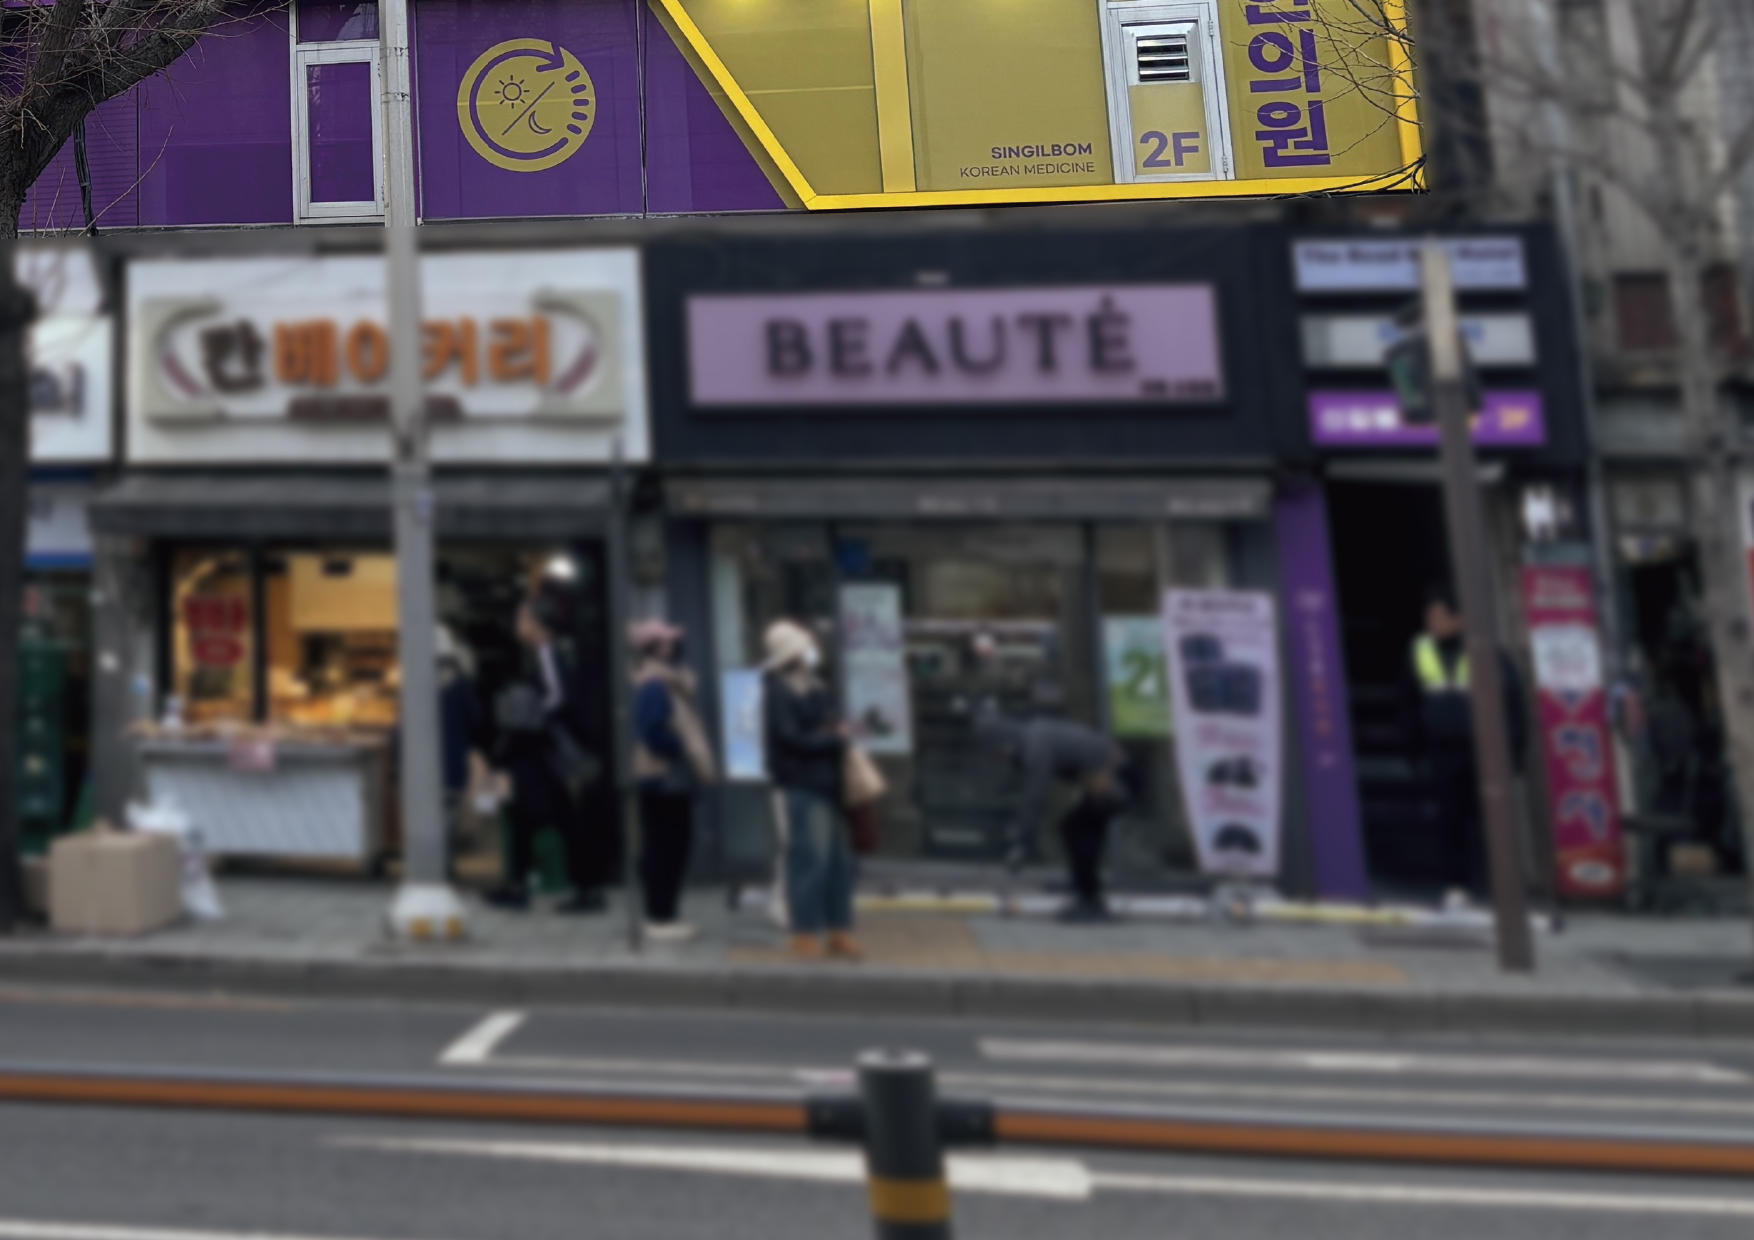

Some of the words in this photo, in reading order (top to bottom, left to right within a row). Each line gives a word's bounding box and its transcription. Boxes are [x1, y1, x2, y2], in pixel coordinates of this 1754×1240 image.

[991, 142, 1093, 159] SINGILBOM
[1142, 130, 1201, 168] 2F
[960, 165, 1020, 178] KOREAN
[1024, 161, 1096, 175] MEDICINE
[763, 294, 1136, 378] BEAUTÉ
